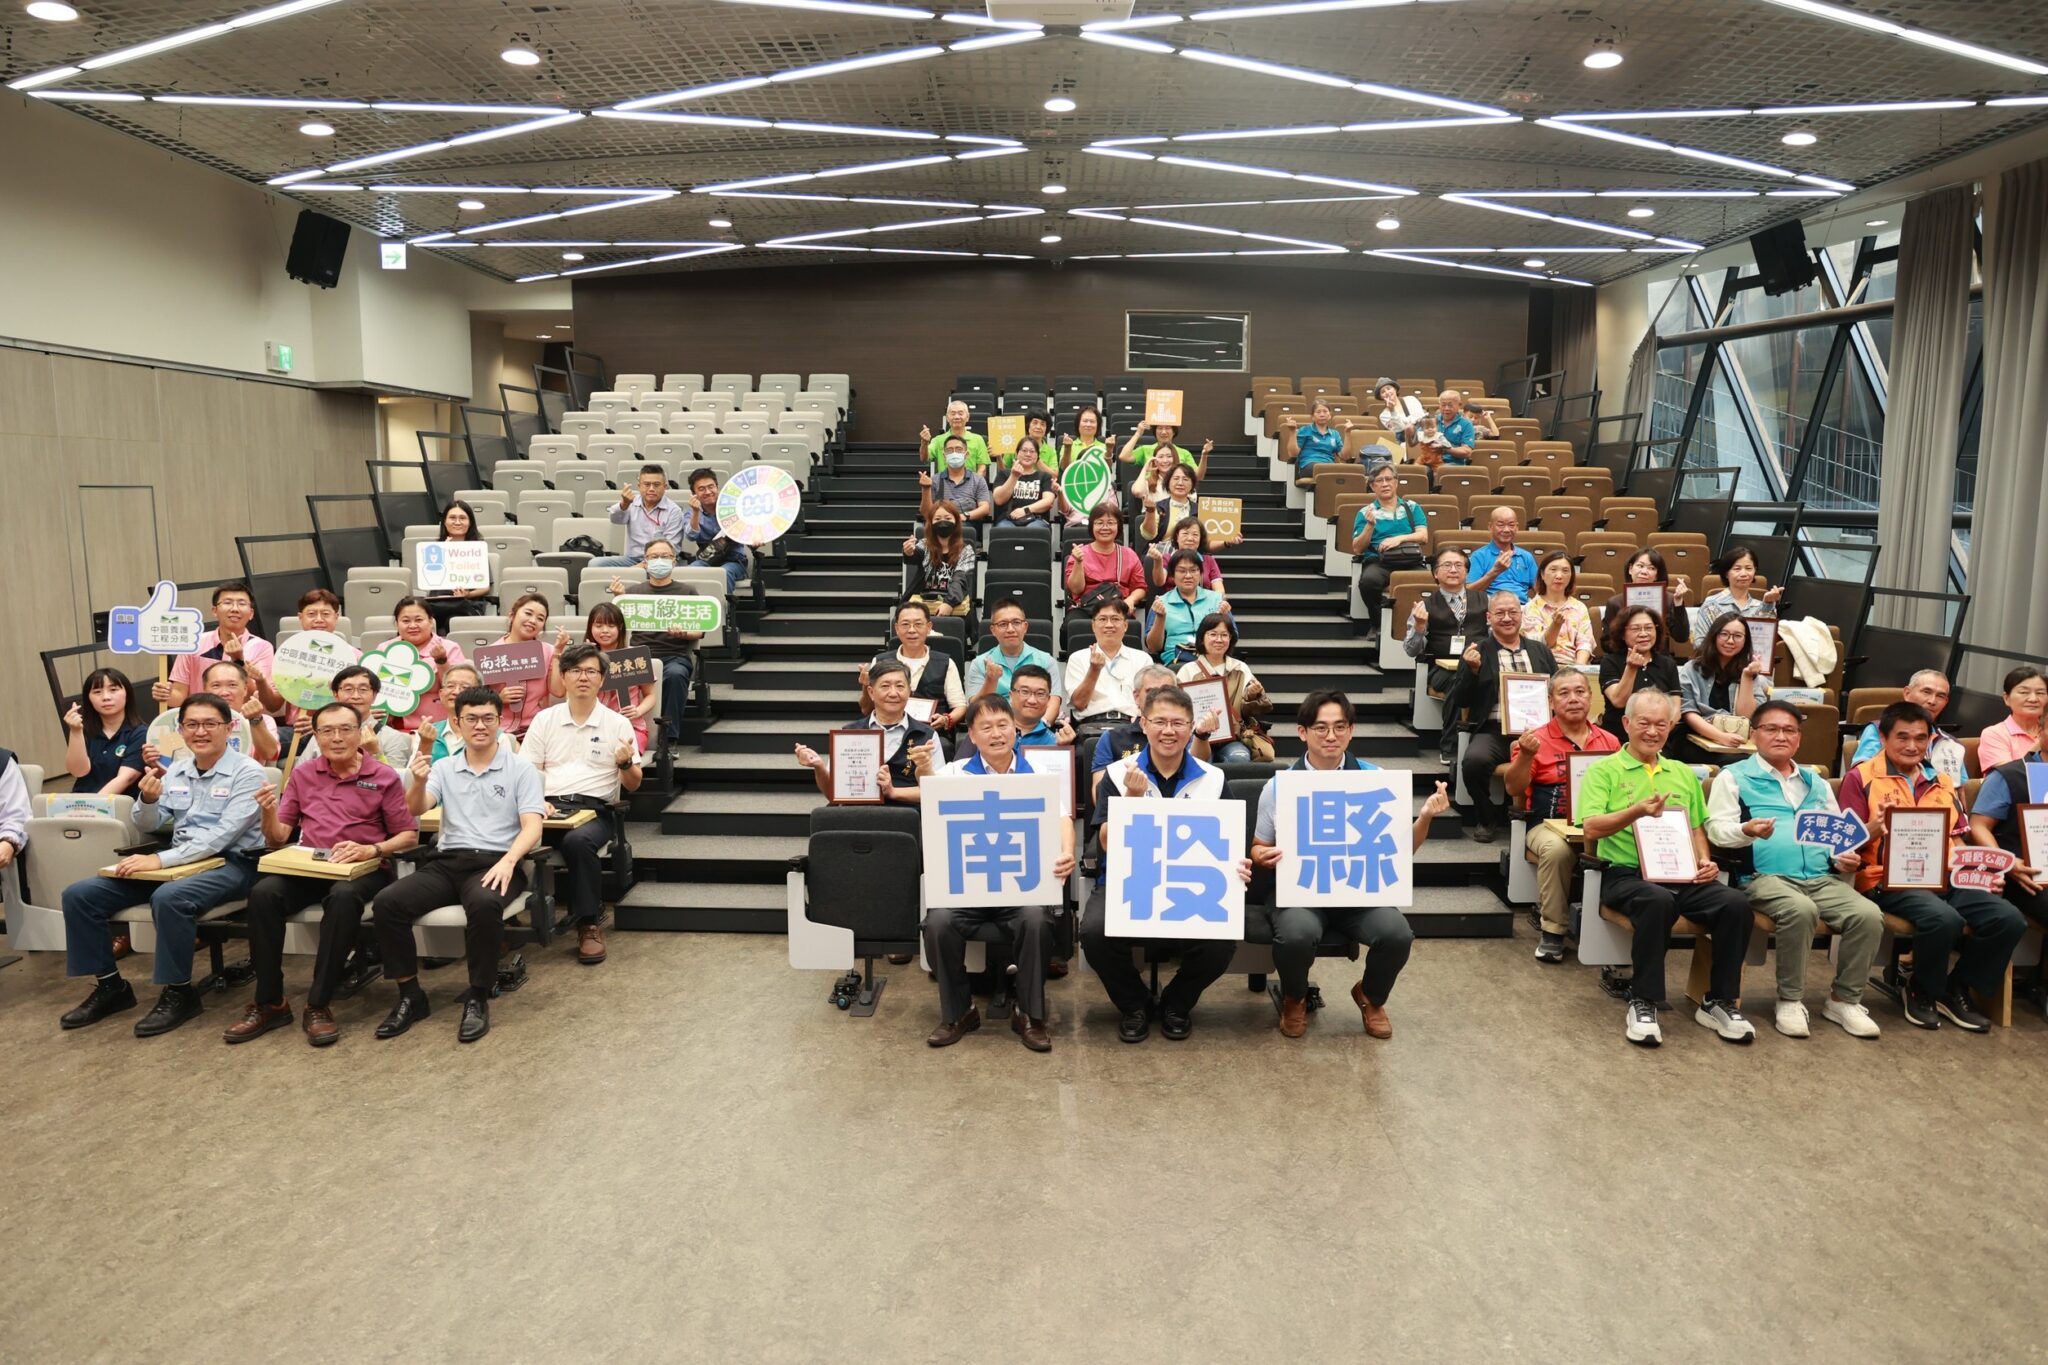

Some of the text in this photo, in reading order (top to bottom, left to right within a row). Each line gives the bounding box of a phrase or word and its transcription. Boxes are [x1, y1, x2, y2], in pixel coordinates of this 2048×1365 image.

[448, 549, 481, 557] World
[449, 562, 481, 570] Toilet
[449, 574, 471, 584] Day
[620, 598, 713, 620] 淨零綠生活
[630, 620, 701, 630] Green Lifestyle
[151, 635, 189, 643] 工程分局
[503, 665, 523, 673] Service
[609, 656, 647, 674] 新東陽
[939, 791, 1045, 894] 南
[1297, 788, 1398, 894] 縣
[1123, 814, 1229, 922] 投
